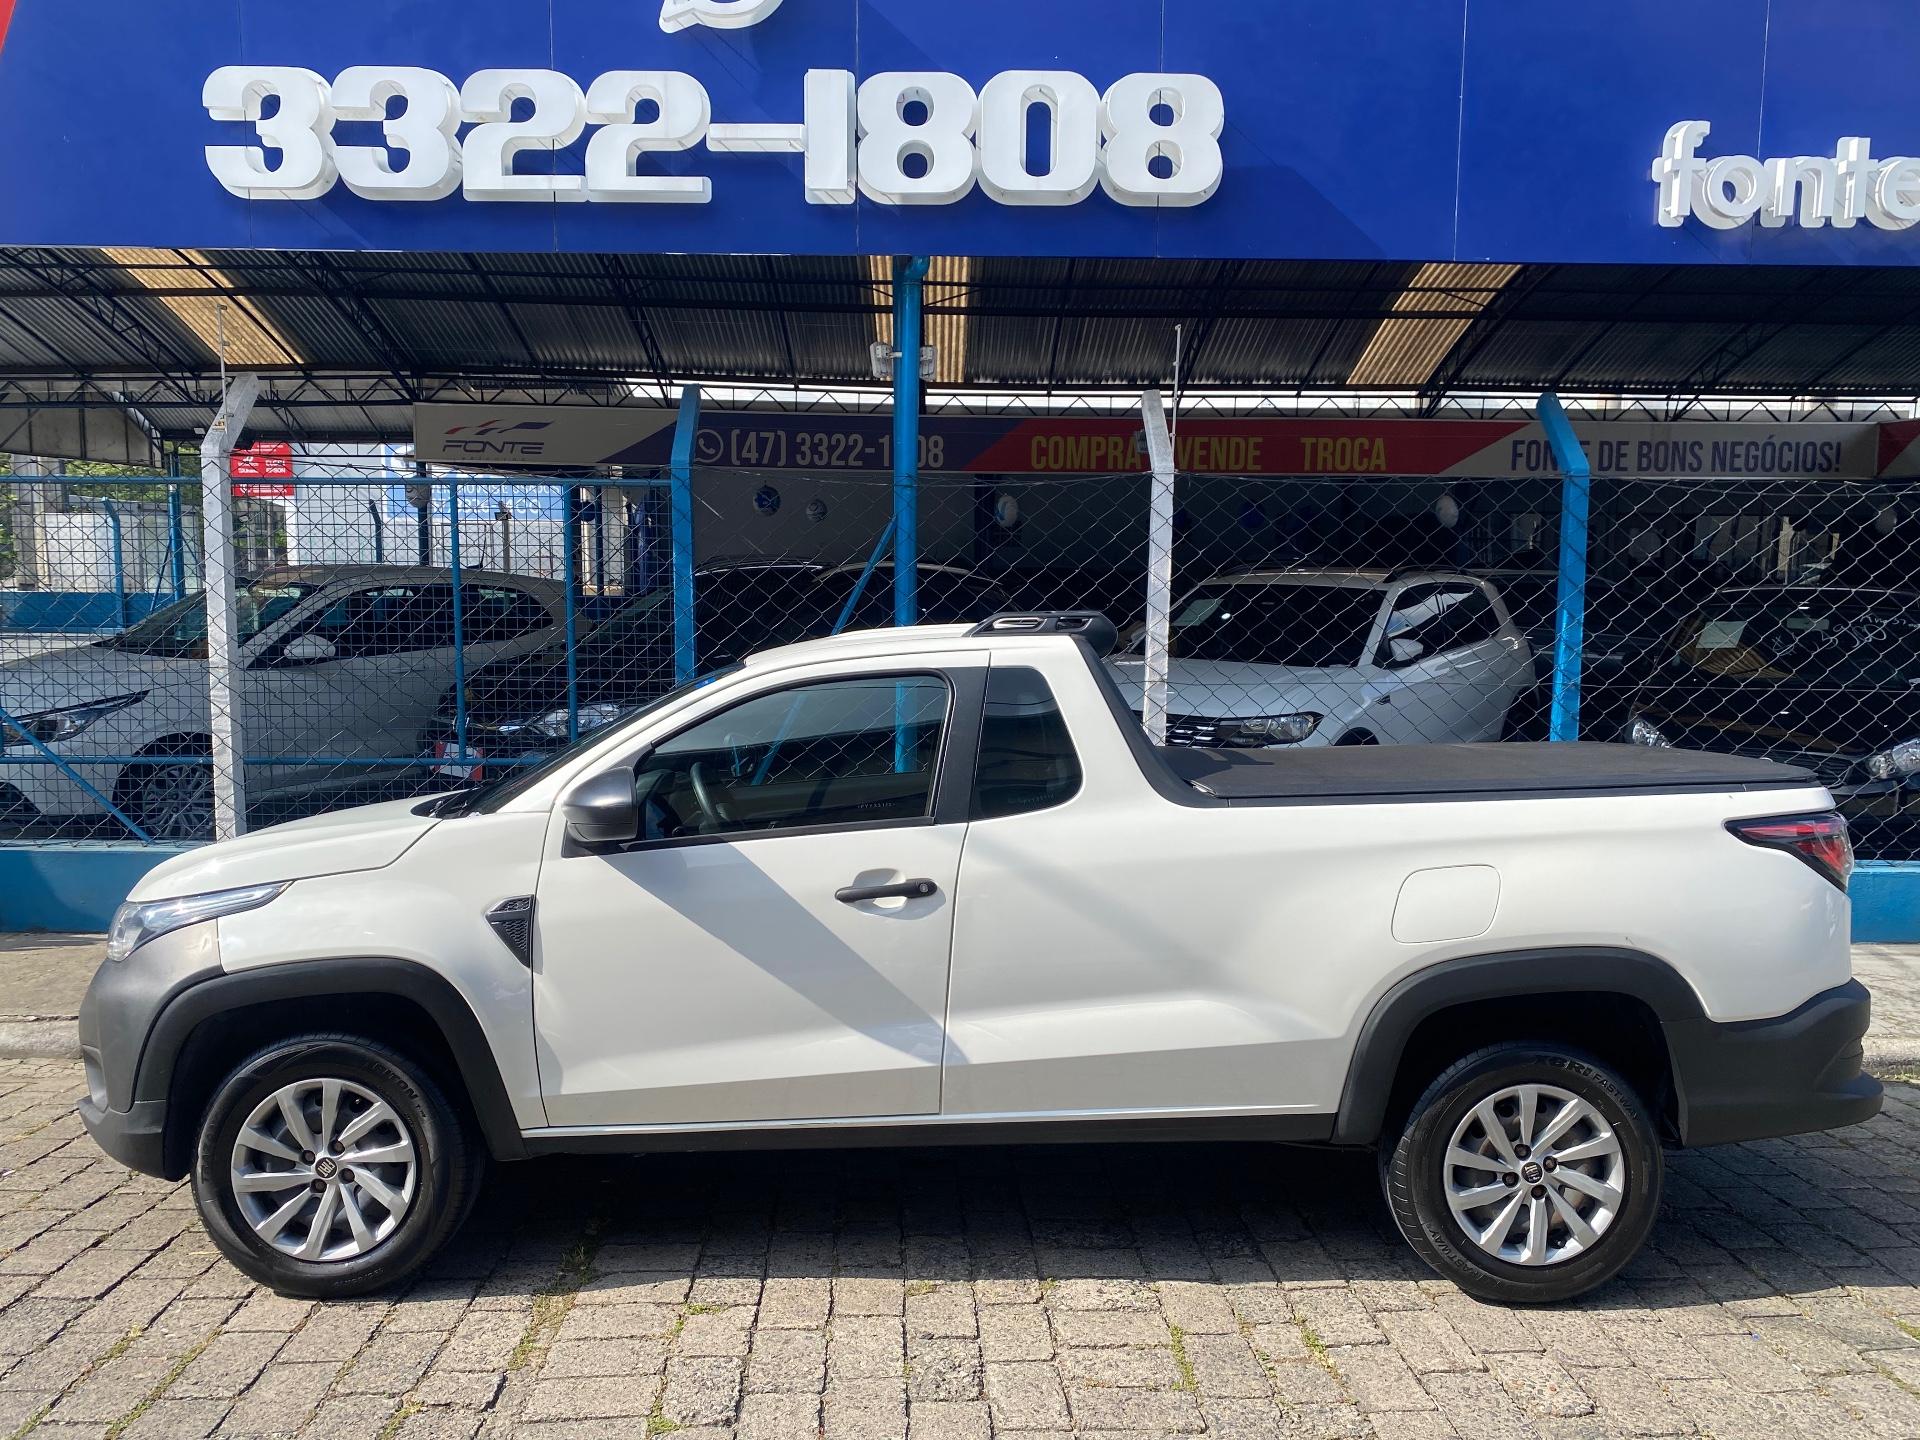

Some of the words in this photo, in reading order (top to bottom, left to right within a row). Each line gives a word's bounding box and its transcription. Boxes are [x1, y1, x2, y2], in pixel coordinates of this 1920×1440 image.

[203, 65, 1226, 208] 3322-1808
[443, 439, 545, 455] FONTE
[730, 428, 787, 468] (47)
[796, 432, 945, 469] 3322-108
[1031, 435, 1142, 471] COMPRA
[1175, 436, 1263, 472] VENDE
[1301, 437, 1387, 472] TROCA
[1511, 439, 1591, 472] FON
[1598, 439, 1630, 472] DE
[1637, 439, 1704, 473] BONS
[1711, 434, 1842, 474] NEGÓCIOS!
